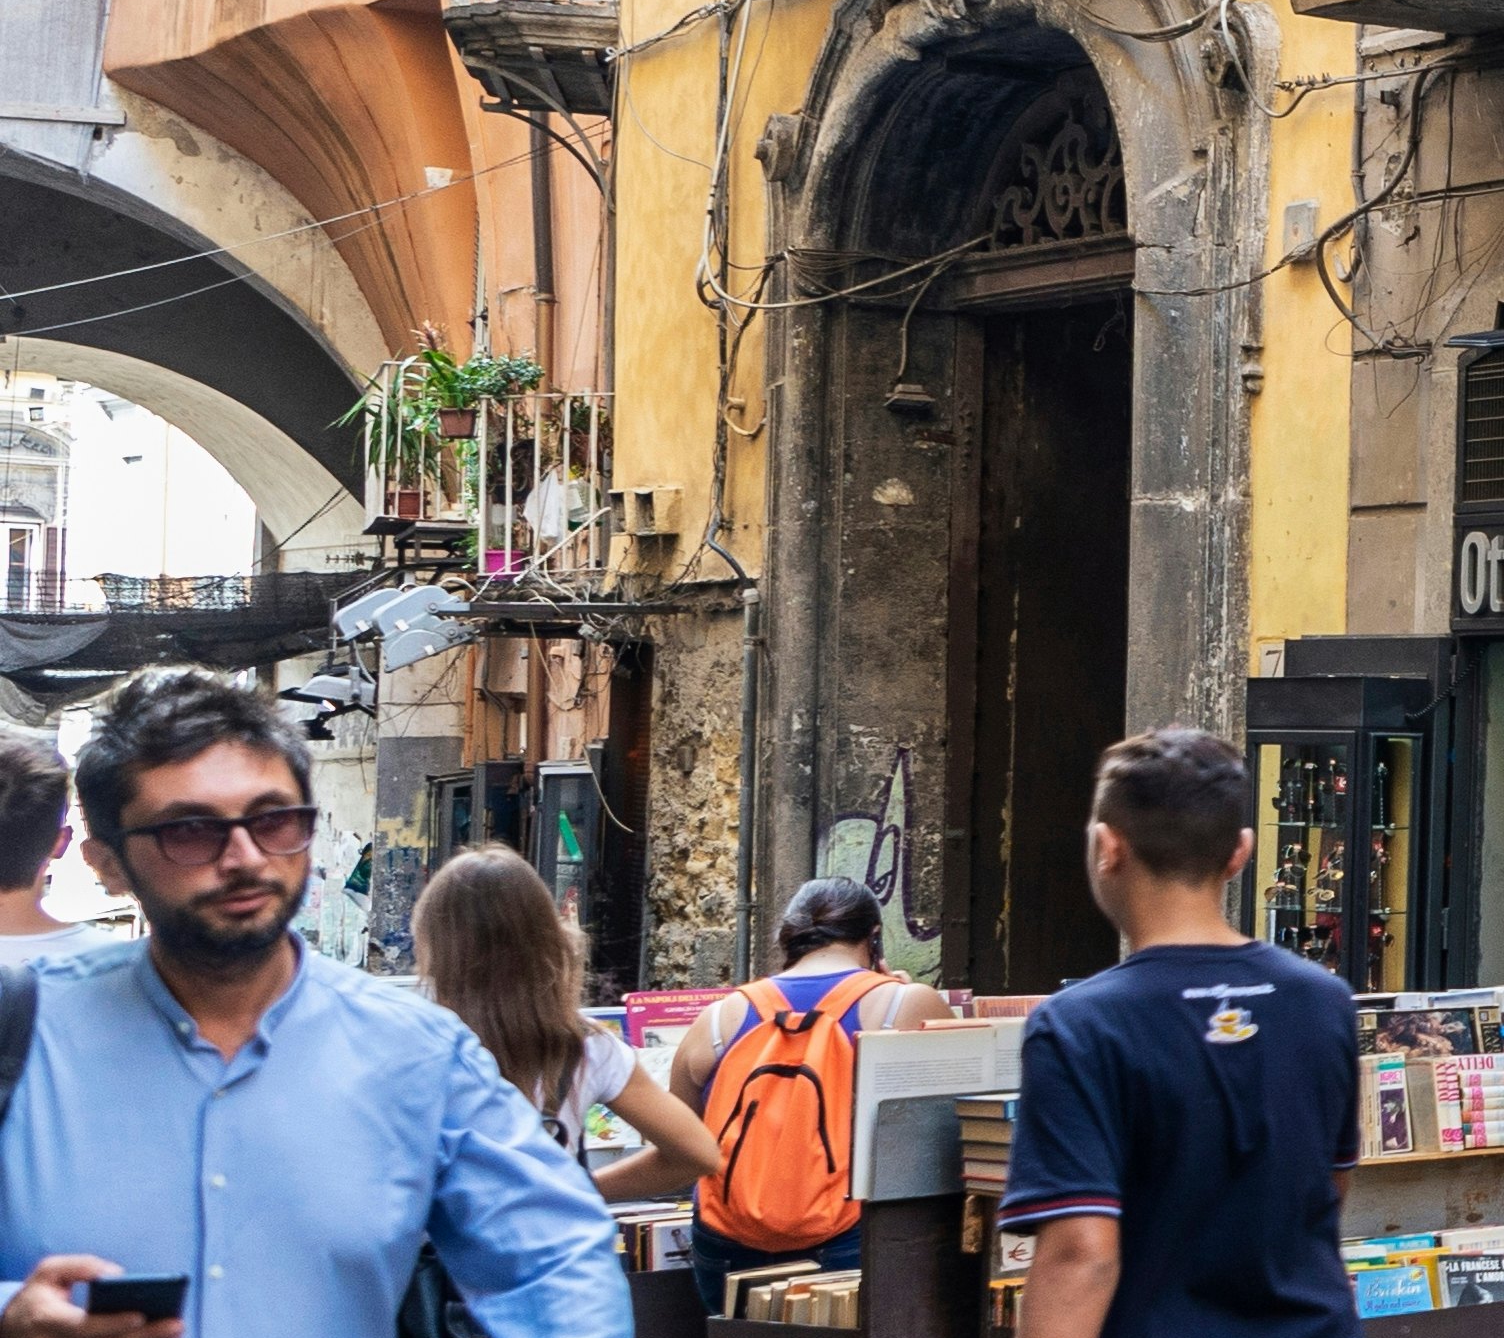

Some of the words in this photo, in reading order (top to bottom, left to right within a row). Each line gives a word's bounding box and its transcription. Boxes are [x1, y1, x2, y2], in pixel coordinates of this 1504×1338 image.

[1265, 649, 1283, 678] 7
[1449, 1260, 1460, 1273] LA
[1460, 1259, 1499, 1273] FRANCESE
